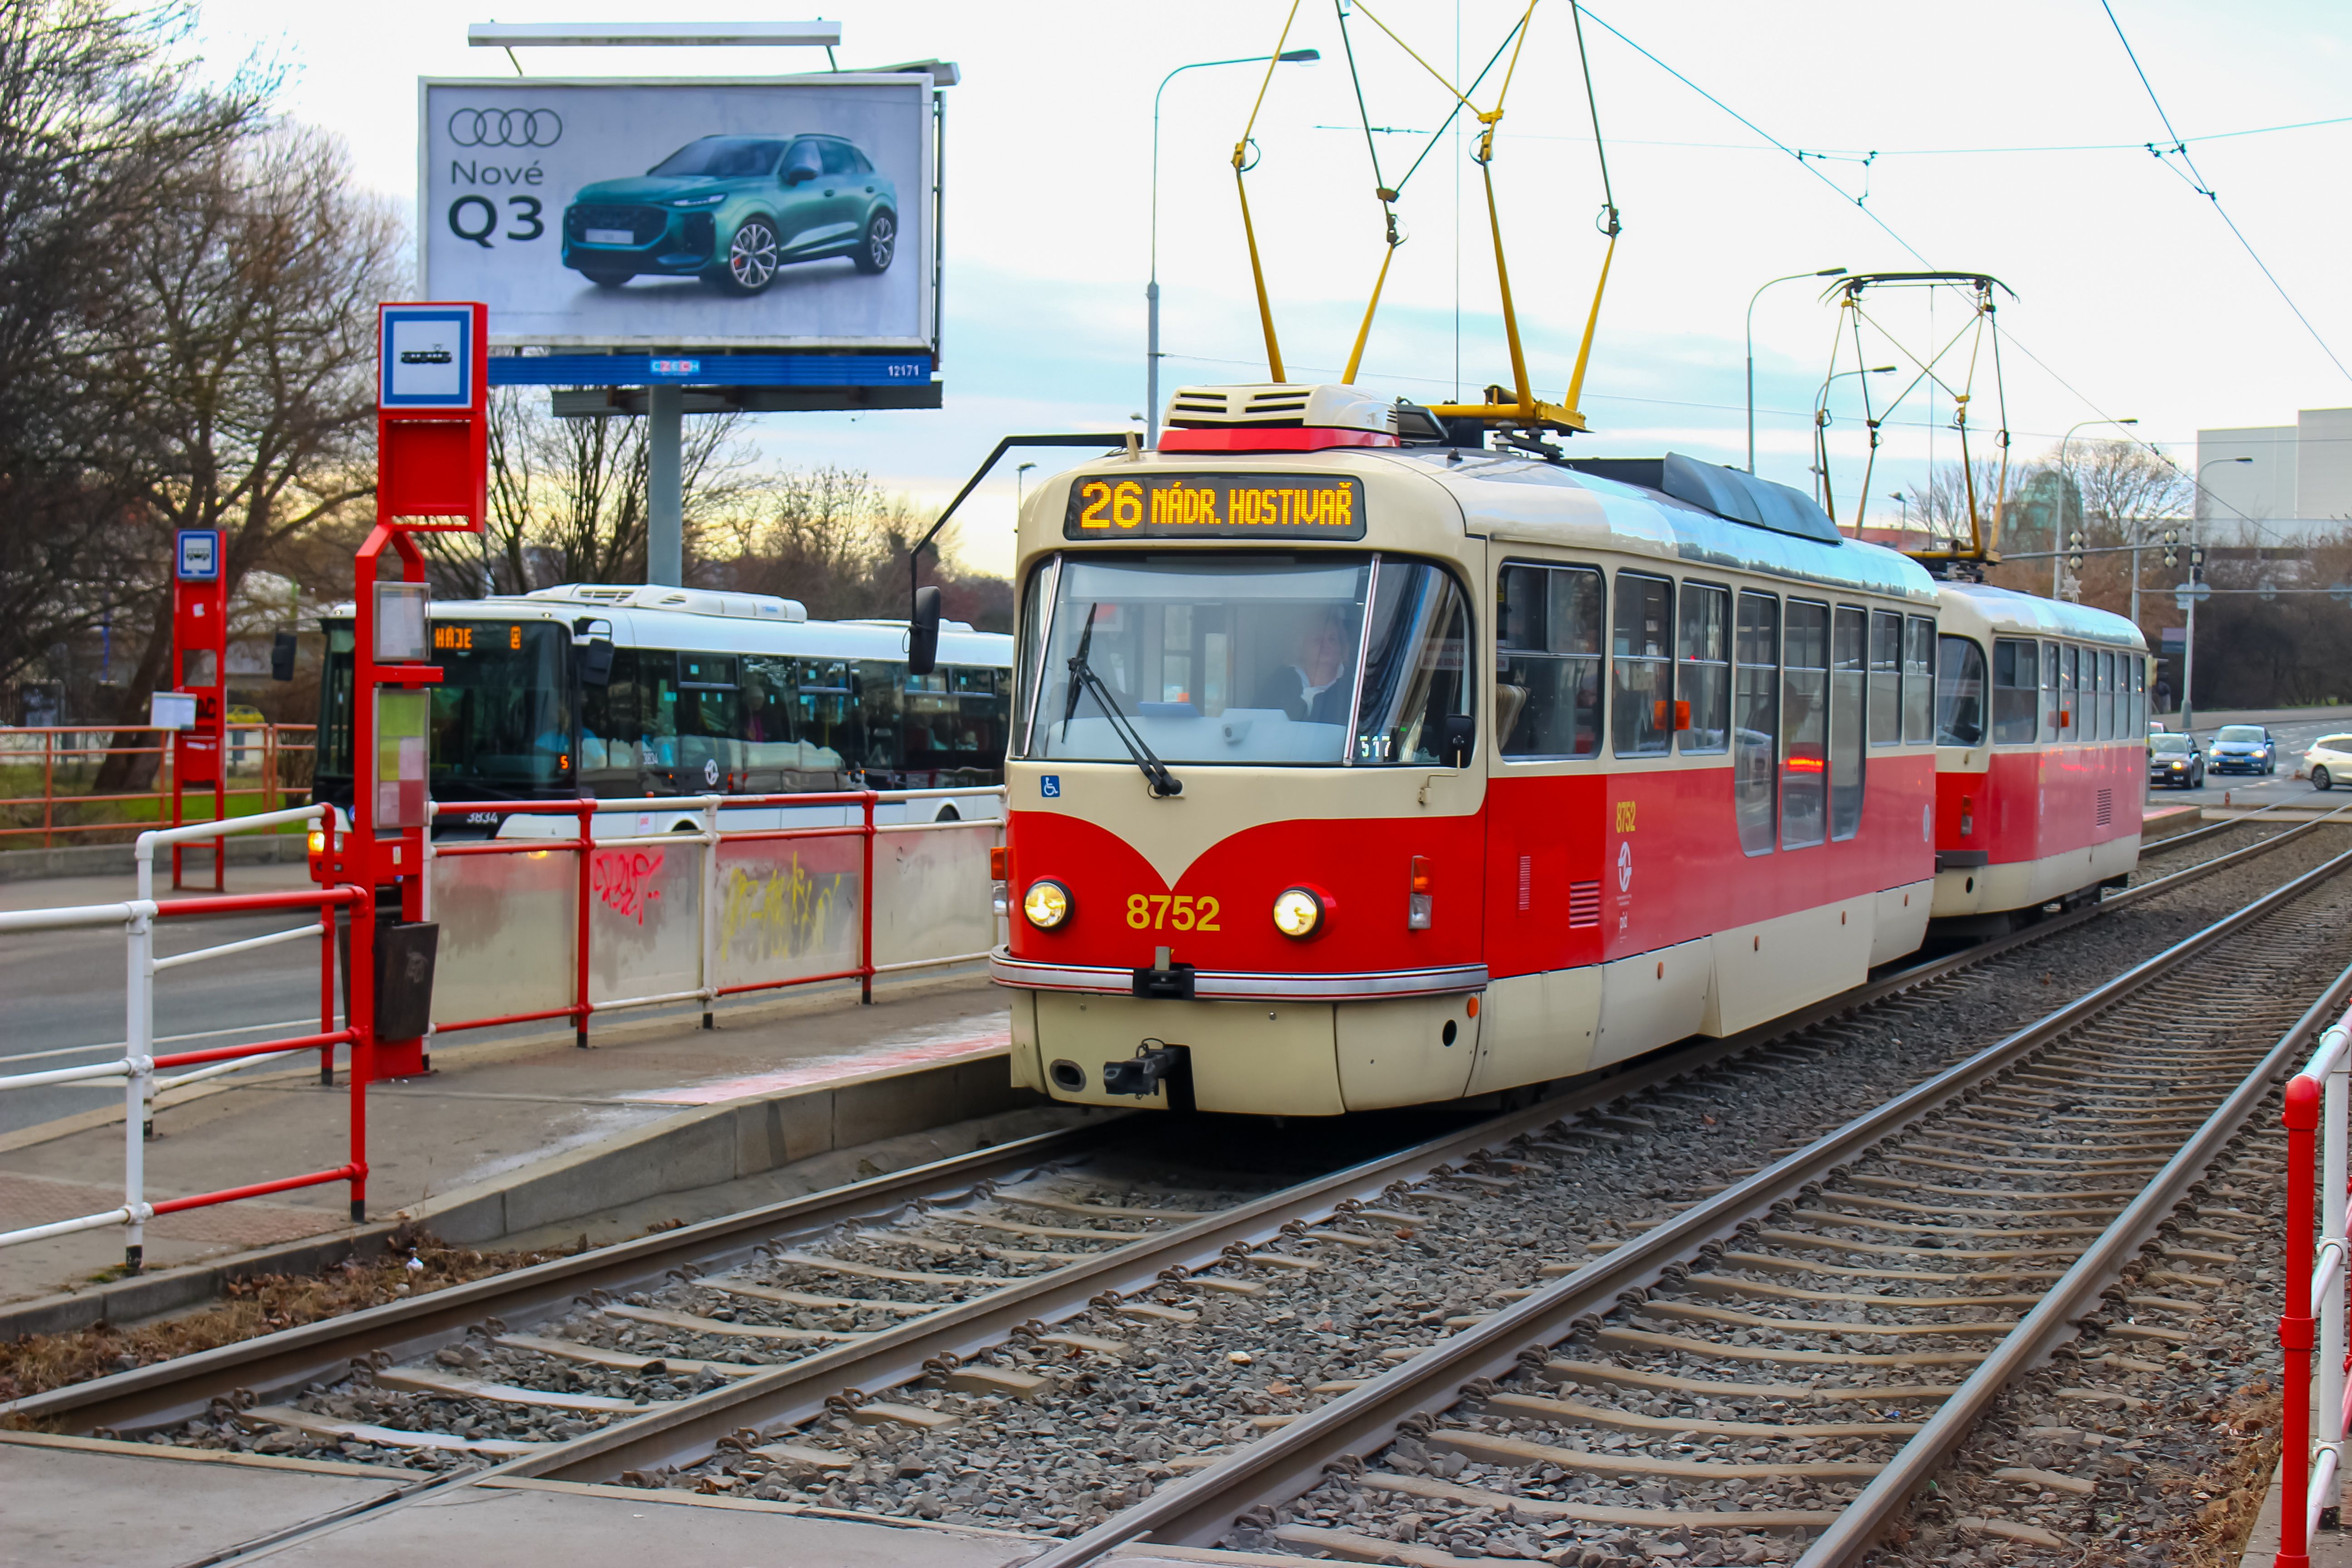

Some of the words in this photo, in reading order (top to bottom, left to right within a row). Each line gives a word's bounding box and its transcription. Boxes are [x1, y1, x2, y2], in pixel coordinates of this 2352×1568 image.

[451, 159, 544, 185] Nové
[449, 194, 544, 249] Q3
[888, 365, 919, 377] 12171
[1081, 481, 1143, 529] 26
[1151, 481, 1222, 524] NÁDR.
[1228, 482, 1352, 525] HOSTIVAŘ
[1360, 735, 1391, 757] 517
[466, 812, 498, 823] 3834
[1616, 801, 1636, 833] 8752
[1126, 893, 1220, 931] 8752
